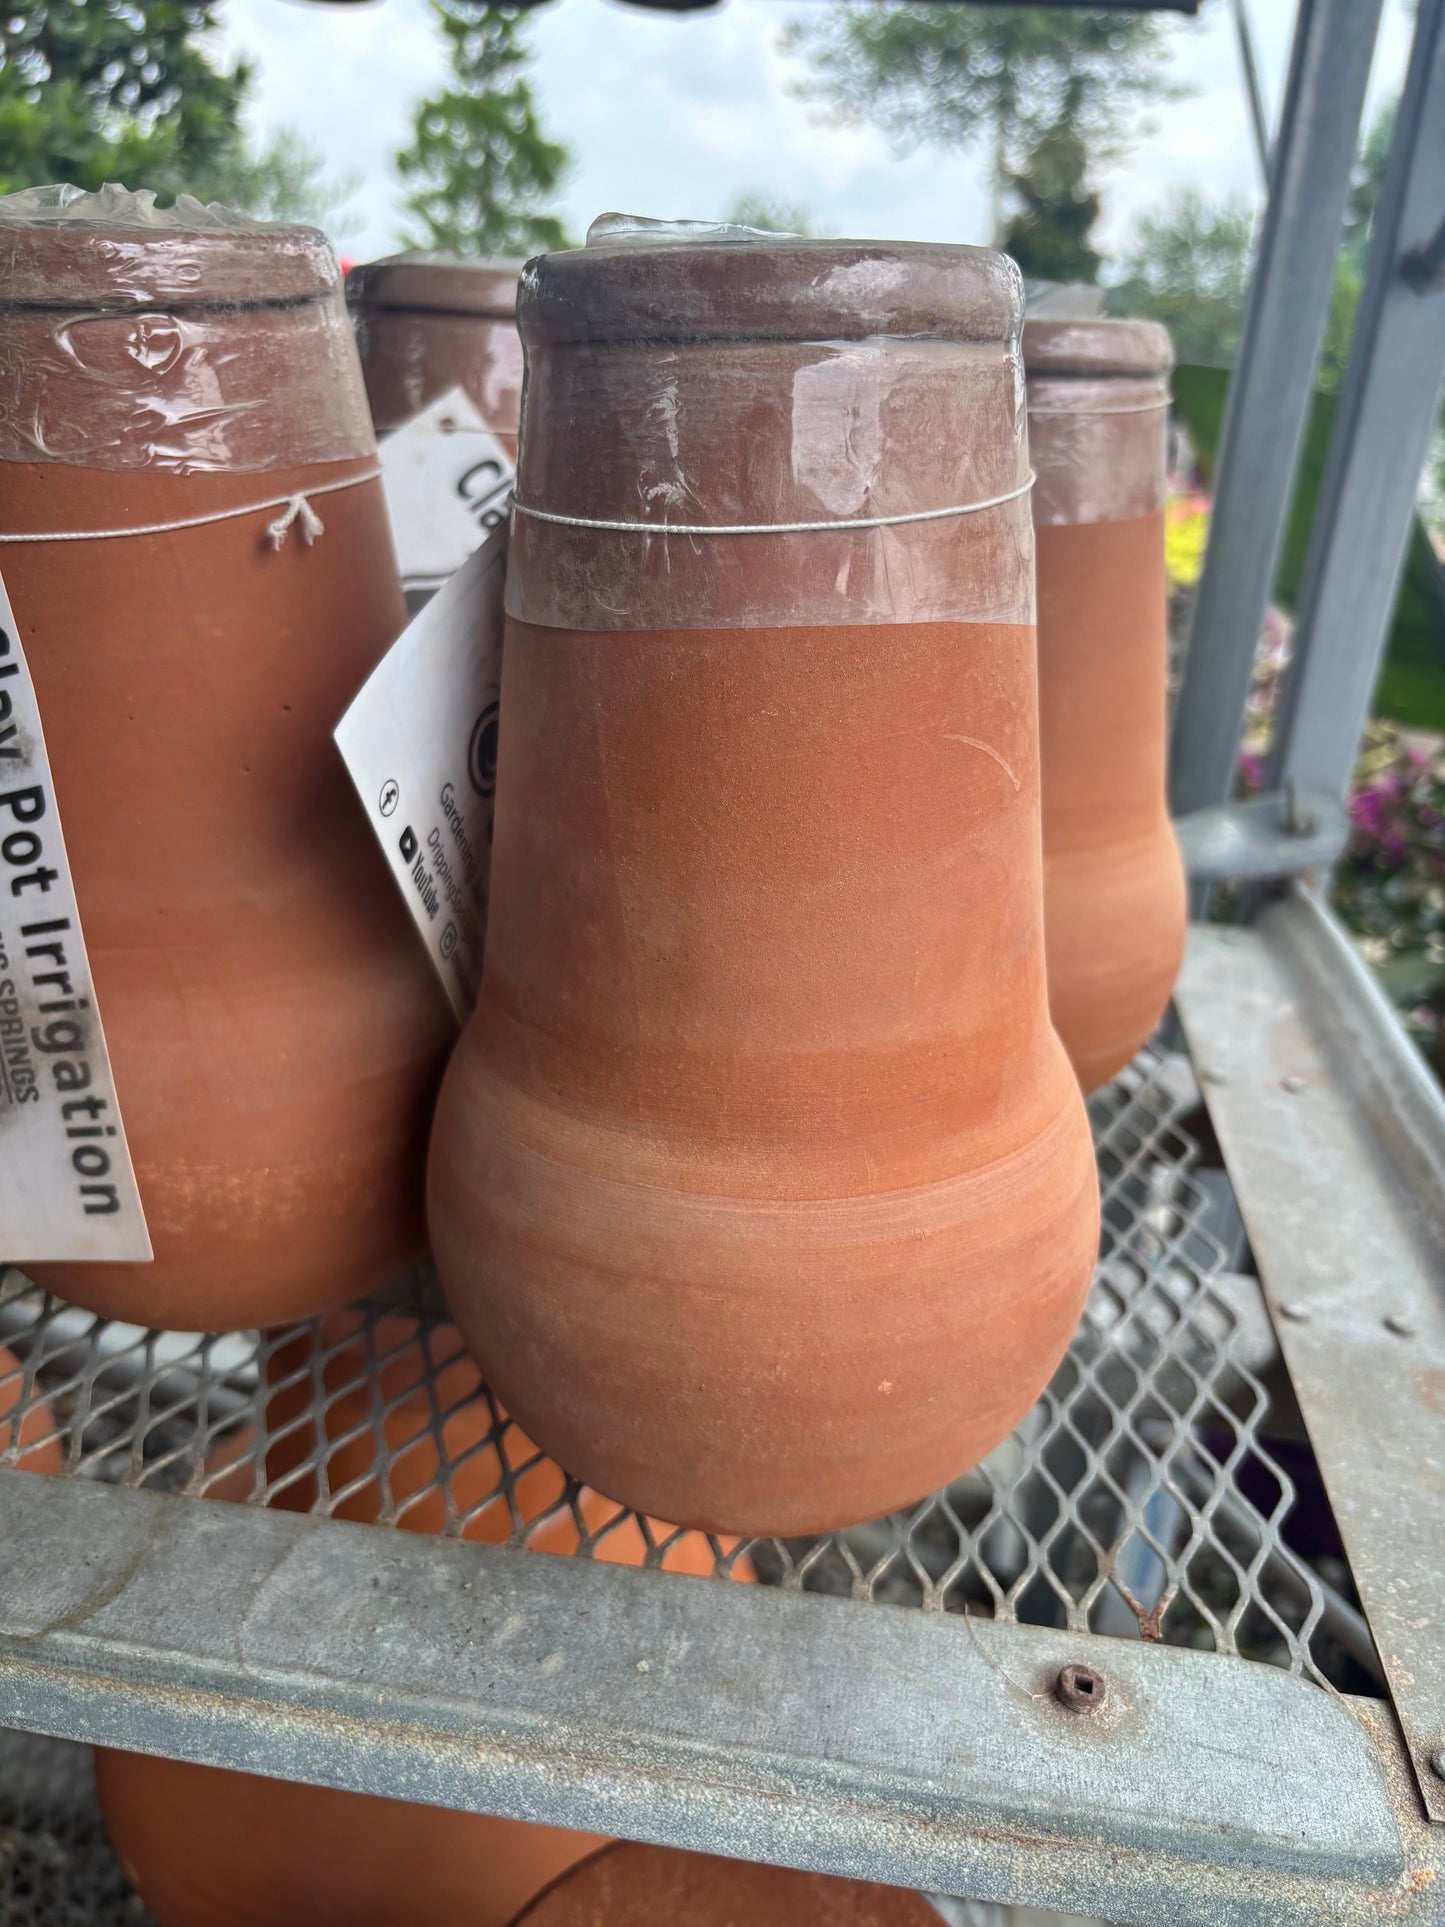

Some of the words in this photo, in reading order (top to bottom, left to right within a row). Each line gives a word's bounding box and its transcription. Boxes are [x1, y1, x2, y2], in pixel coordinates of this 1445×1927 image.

[0, 785, 58, 897] Pot
[410, 851, 440, 921] YouTube
[440, 782, 477, 885] Gardening
[0, 978, 40, 1104] SPRINGS
[20, 917, 120, 1215] Irrigation
